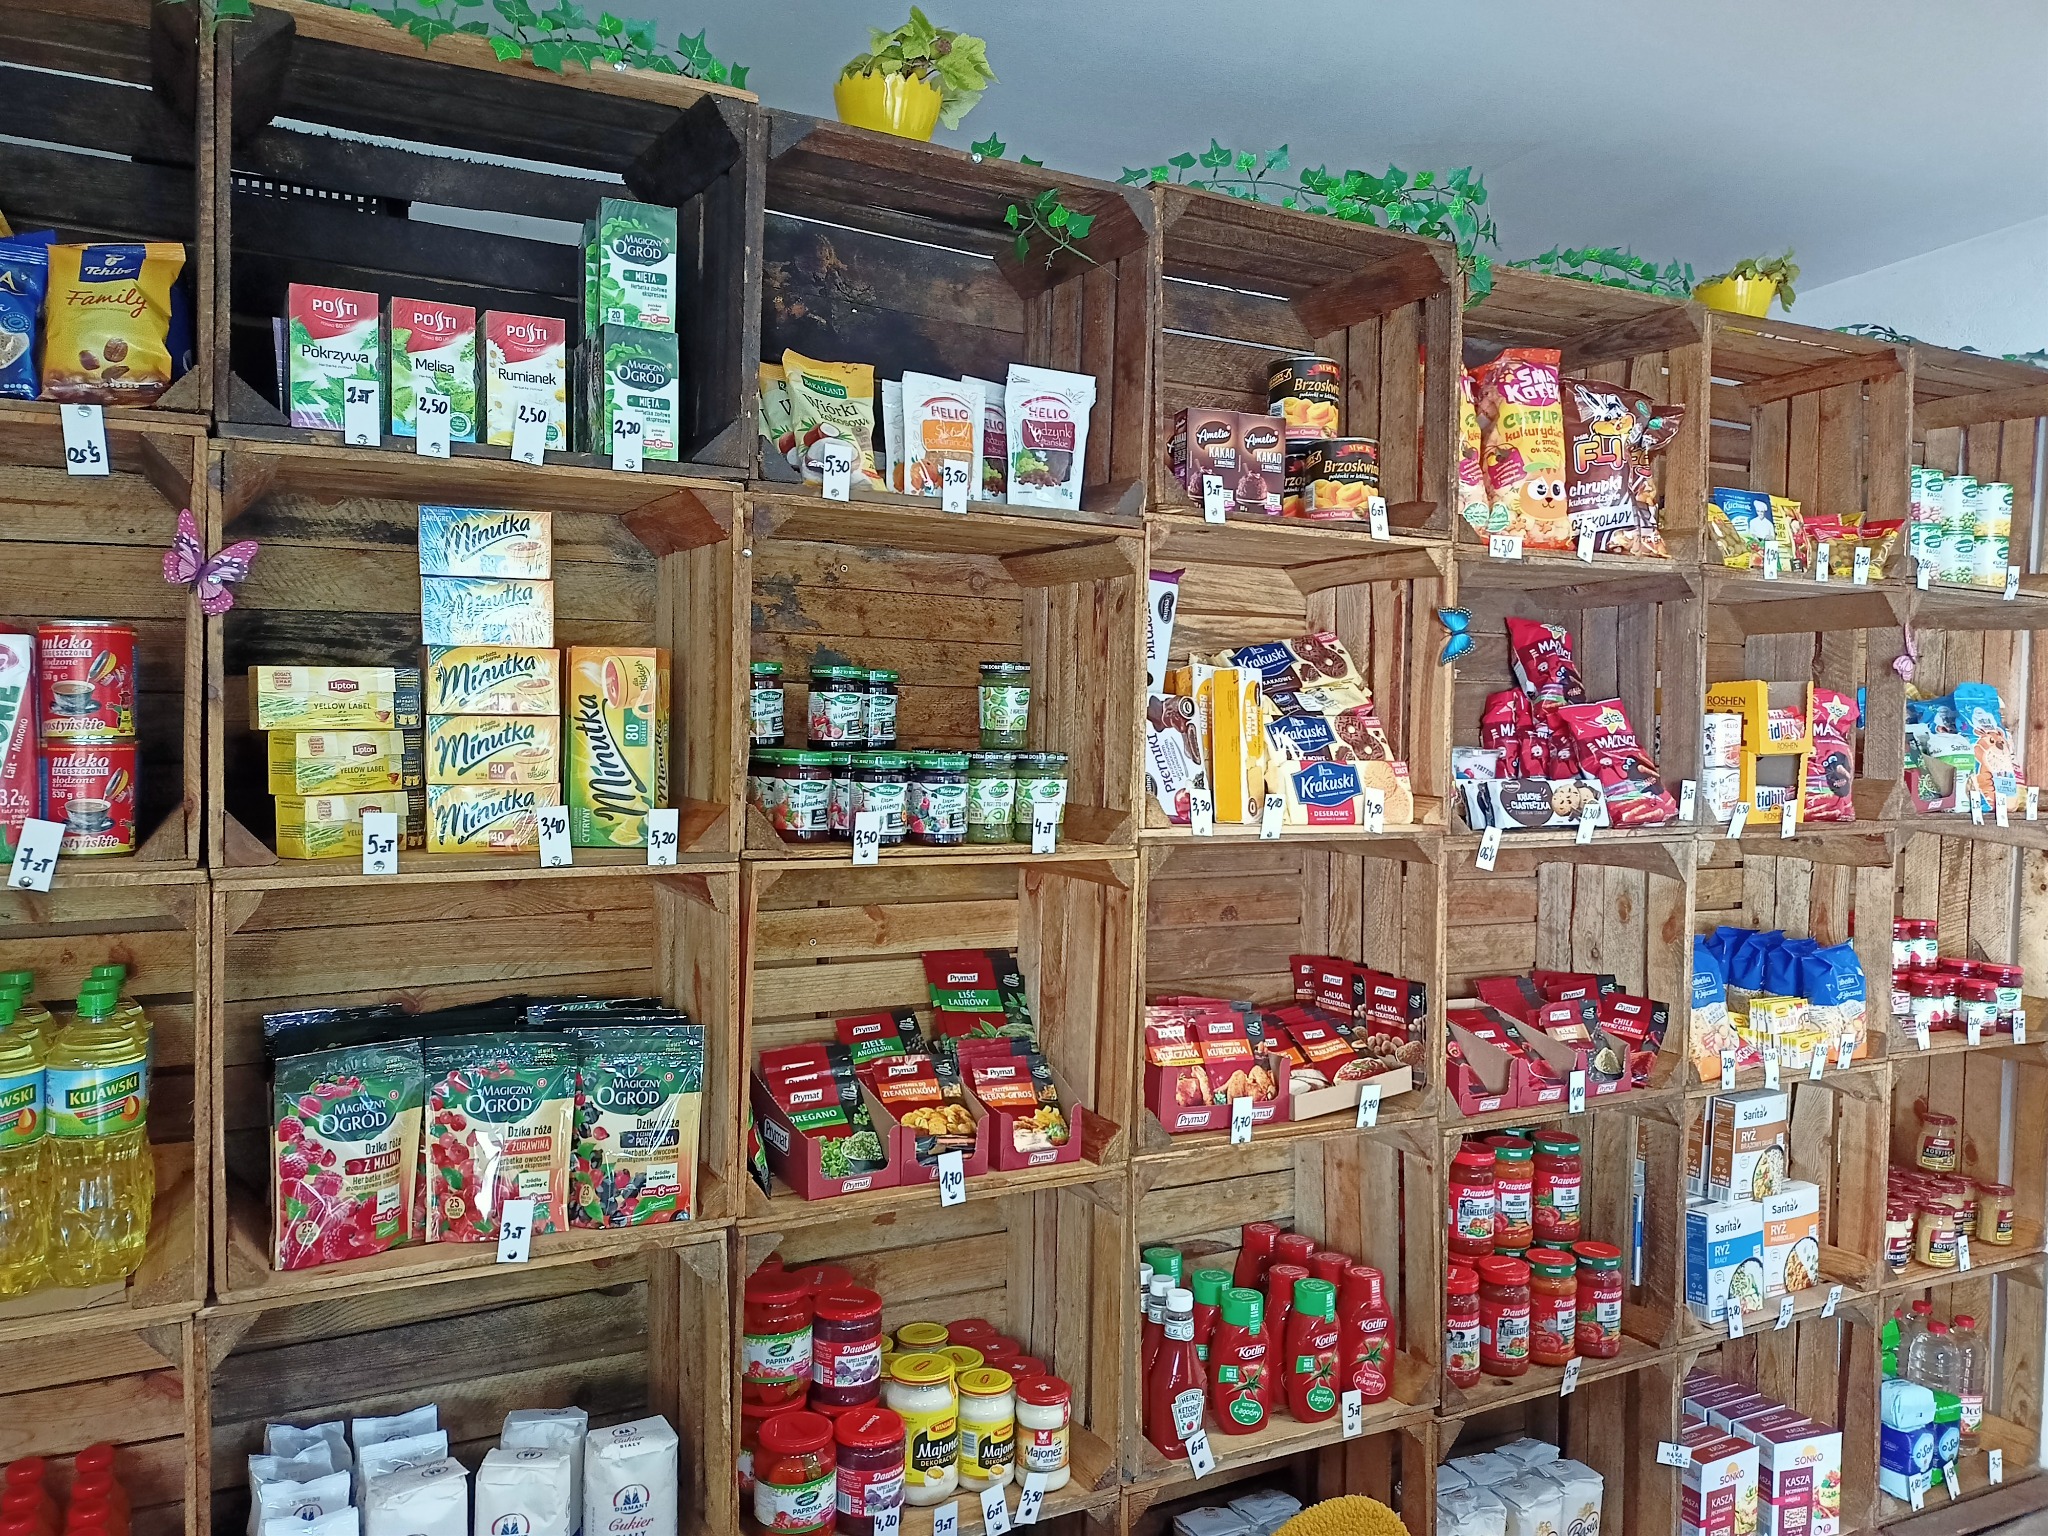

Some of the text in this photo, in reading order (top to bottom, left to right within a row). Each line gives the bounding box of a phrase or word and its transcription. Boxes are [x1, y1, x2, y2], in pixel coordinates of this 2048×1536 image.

[624, 233, 663, 248] MAGICZNY
[613, 240, 662, 260] OGRÓD
[85, 266, 136, 276] Tchibo
[66, 288, 148, 318] Family
[301, 343, 369, 364] Pokrzywa
[415, 357, 455, 374] Melisa
[627, 359, 666, 372] MAGICZNY
[498, 368, 556, 386] Rumianek
[616, 364, 665, 385] OGRÓD
[803, 378, 846, 397] BAKALLAND
[419, 396, 448, 418] 2,50
[803, 393, 858, 416] Wiórki
[518, 405, 547, 427] 2,50
[931, 406, 968, 420] HELIO
[614, 420, 641, 439] 2,20
[1196, 427, 1231, 443] Amelia
[1245, 432, 1279, 449] Amelia
[1209, 447, 1236, 459] KAKAO
[1256, 452, 1283, 464] KAKAO
[825, 455, 851, 476] 5,30
[944, 466, 968, 486] 3,50
[1569, 476, 1623, 497] chrupki
[445, 515, 531, 556] Minutka
[1493, 539, 1515, 553] 2,50
[42, 635, 94, 650] mleko
[1236, 647, 1288, 669] Krakuski
[331, 682, 357, 690] Lipton
[436, 654, 537, 706] Minutka
[313, 702, 372, 711] YELLOW LABEL
[1706, 696, 1746, 706] ROSHEN
[625, 724, 640, 741] 80
[355, 745, 377, 754] Lipton
[435, 721, 536, 777] Minutka
[52, 752, 110, 768] mleko
[574, 694, 649, 822] Minutka
[340, 765, 385, 775] YELLOW LABEL
[490, 764, 504, 774] 40
[52, 776, 96, 785] słodzone
[1300, 772, 1354, 799] Krakuski
[52, 791, 65, 799] 530
[1756, 789, 1785, 809] tidbit
[1191, 797, 1211, 817] 3,30
[1367, 799, 1383, 819] 4,50
[1510, 801, 1551, 810] CIASTECZKA
[436, 787, 536, 846] Minutka
[1313, 810, 1350, 818] DESEROWE
[540, 816, 566, 841] 3,40
[581, 807, 590, 844] CYTRYNY
[651, 829, 677, 849] 5,20
[856, 829, 878, 849] 3,50
[949, 973, 977, 983] Prymat
[957, 989, 977, 999] LIŚĆ
[948, 998, 990, 1007] LAUROWY
[1375, 1003, 1398, 1014] GAŁKA
[1211, 1024, 1232, 1033] Prymat
[1613, 1017, 1634, 1027] CHILI
[855, 1024, 881, 1035] Prymat
[857, 1045, 894, 1057] ANGIELSKIE
[861, 1039, 886, 1049] ZIELE
[1206, 1046, 1248, 1057] KURCZAKA
[891, 1066, 917, 1075] Prymat
[990, 1068, 1014, 1077] Prymat
[68, 1073, 139, 1107] KUJAWSKI
[482, 1085, 534, 1097] MAGICZNY
[612, 1078, 662, 1090] MAGICZNY
[882, 1084, 938, 1098] ZIEMNIAKÓW
[596, 1086, 660, 1106] OGRÓD
[793, 1090, 820, 1102] Prymat
[334, 1098, 387, 1116] MAGICZNY
[465, 1094, 533, 1114] OGRÓD
[788, 1109, 837, 1124] OREGANO
[1180, 1113, 1206, 1125] Prymat
[1743, 1109, 1764, 1121] Sarita
[319, 1111, 387, 1136] OGRÓD
[1233, 1115, 1251, 1133] 1,70
[507, 1124, 552, 1138] Dzika róża
[765, 1120, 789, 1150] Prymat
[1741, 1129, 1757, 1143] RYŻ
[365, 1142, 388, 1156] Dzika
[364, 1159, 371, 1172] Z
[1032, 1153, 1056, 1165] Prymat
[845, 1179, 870, 1190] Prymat
[448, 1198, 460, 1209] 25
[1772, 1202, 1794, 1215] Sarita
[1715, 1222, 1738, 1234] Sarita
[1770, 1223, 1787, 1236] RYŻ
[1714, 1243, 1730, 1256] RYŻ
[1361, 1319, 1388, 1331] Kotlin
[1315, 1333, 1338, 1347] Kotlin
[841, 1340, 878, 1355] Dawtona
[1239, 1345, 1265, 1358] Kotlin
[765, 1356, 796, 1366] PAPRYKA
[1355, 1375, 1384, 1389] Pikantny
[1181, 1393, 1199, 1405] HEINZ
[1178, 1403, 1200, 1414] KETCHUP
[1234, 1405, 1261, 1418] Łagodny
[934, 1418, 955, 1432] WINIARY
[1024, 1446, 1063, 1463] Majonez
[1794, 1453, 1824, 1466] SONKO
[1719, 1470, 1745, 1486] SONKO
[1785, 1474, 1811, 1488] KASZA
[1023, 1489, 1042, 1506] 5,50
[1711, 1493, 1734, 1508] KASZA
[614, 1501, 650, 1513] DIAMANT
[792, 1503, 823, 1516] PAPRYKA
[608, 1515, 655, 1532] Cukier
[875, 1514, 898, 1532] 4,20
